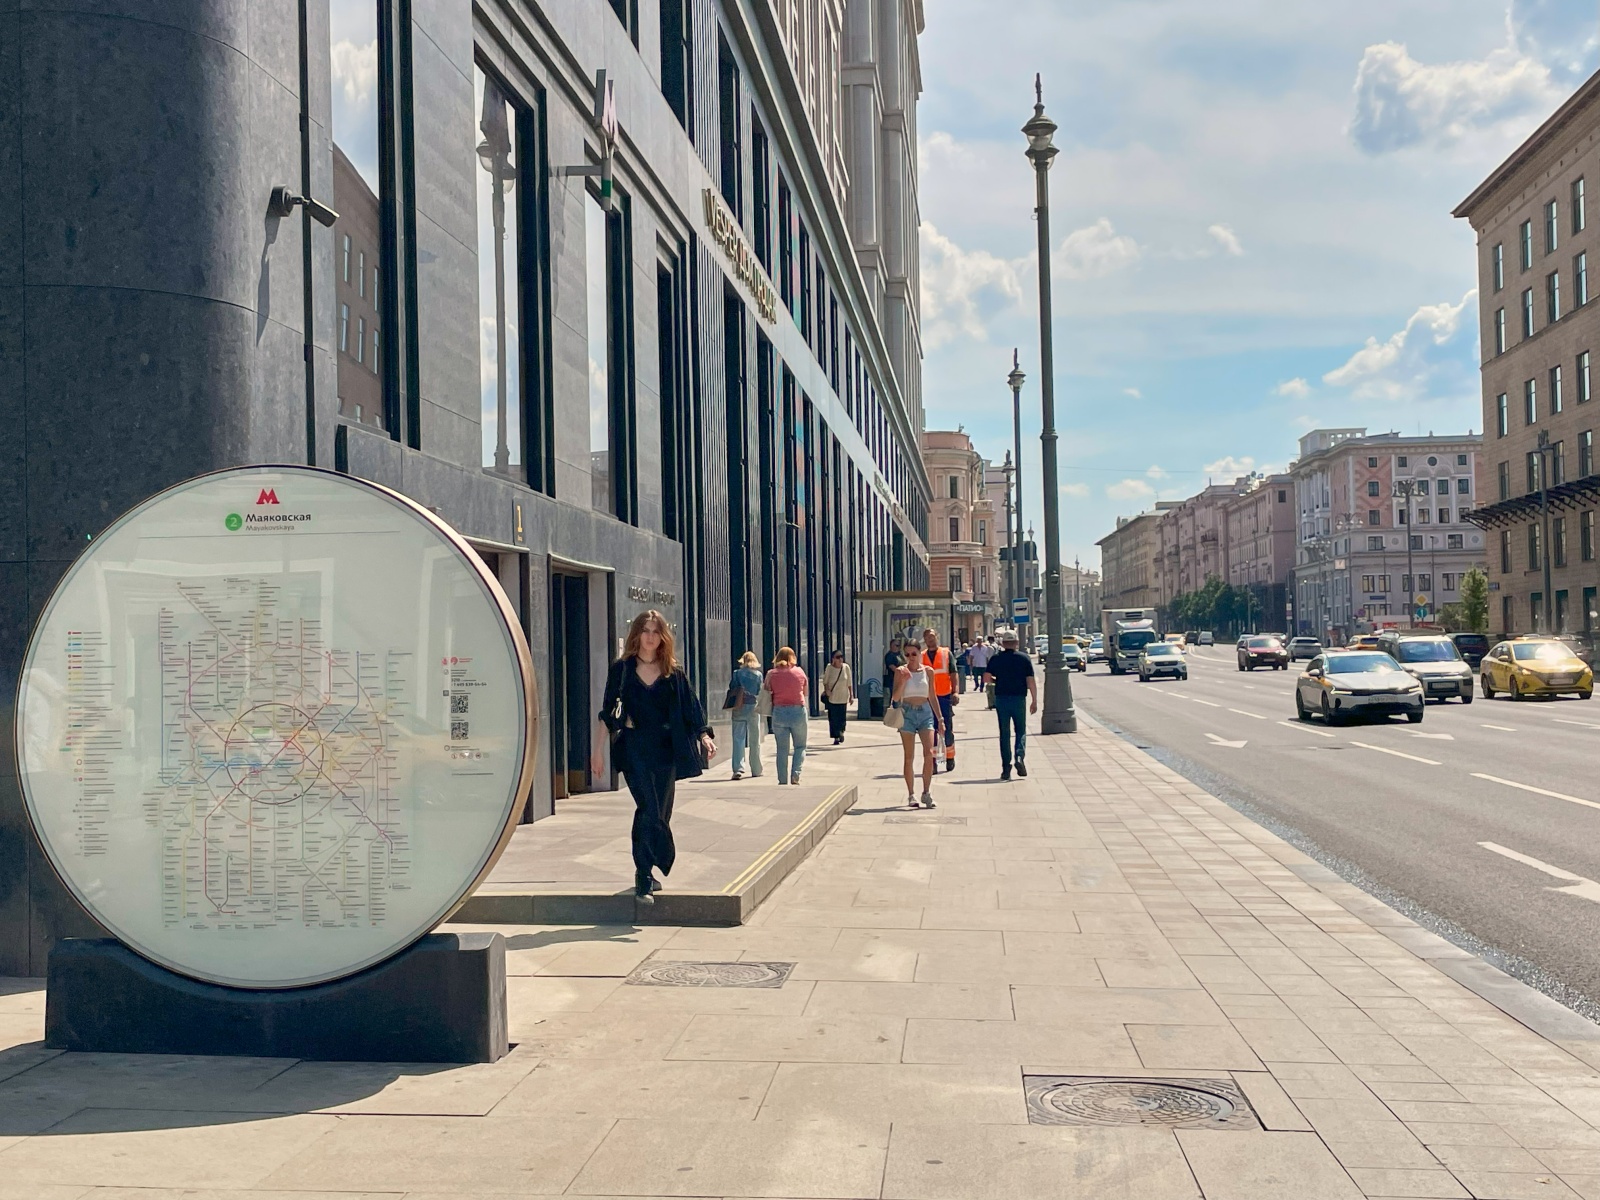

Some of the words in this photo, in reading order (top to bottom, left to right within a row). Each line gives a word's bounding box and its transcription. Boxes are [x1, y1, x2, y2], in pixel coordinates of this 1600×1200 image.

[230, 517, 238, 528] 2
[245, 513, 312, 523] Маяковская
[516, 505, 523, 533] 1
[245, 524, 295, 532] Mayakovskaya
